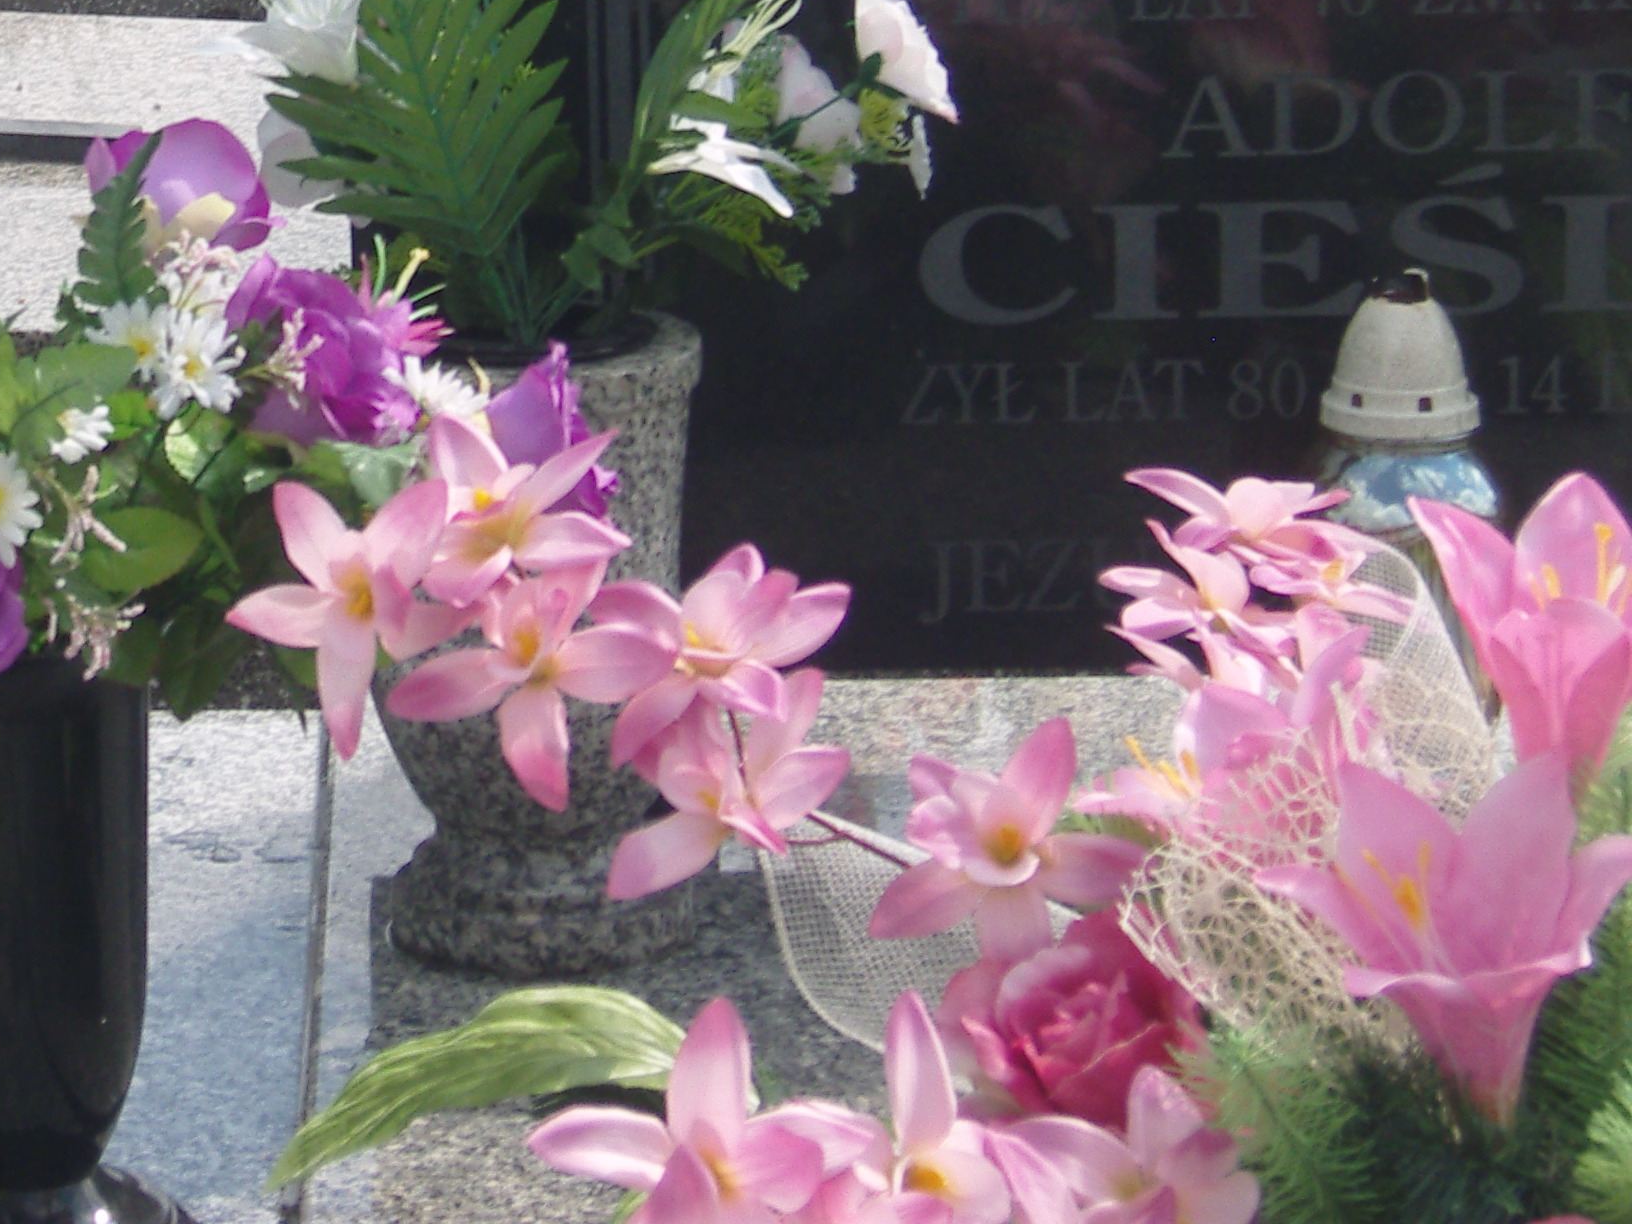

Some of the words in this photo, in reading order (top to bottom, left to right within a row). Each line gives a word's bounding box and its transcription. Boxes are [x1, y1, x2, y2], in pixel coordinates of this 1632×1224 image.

[901, 349, 1037, 426] ŻYŁ
[1062, 358, 1205, 424] LAT
[1227, 357, 1308, 421] 80
[1496, 354, 1568, 415] 14
